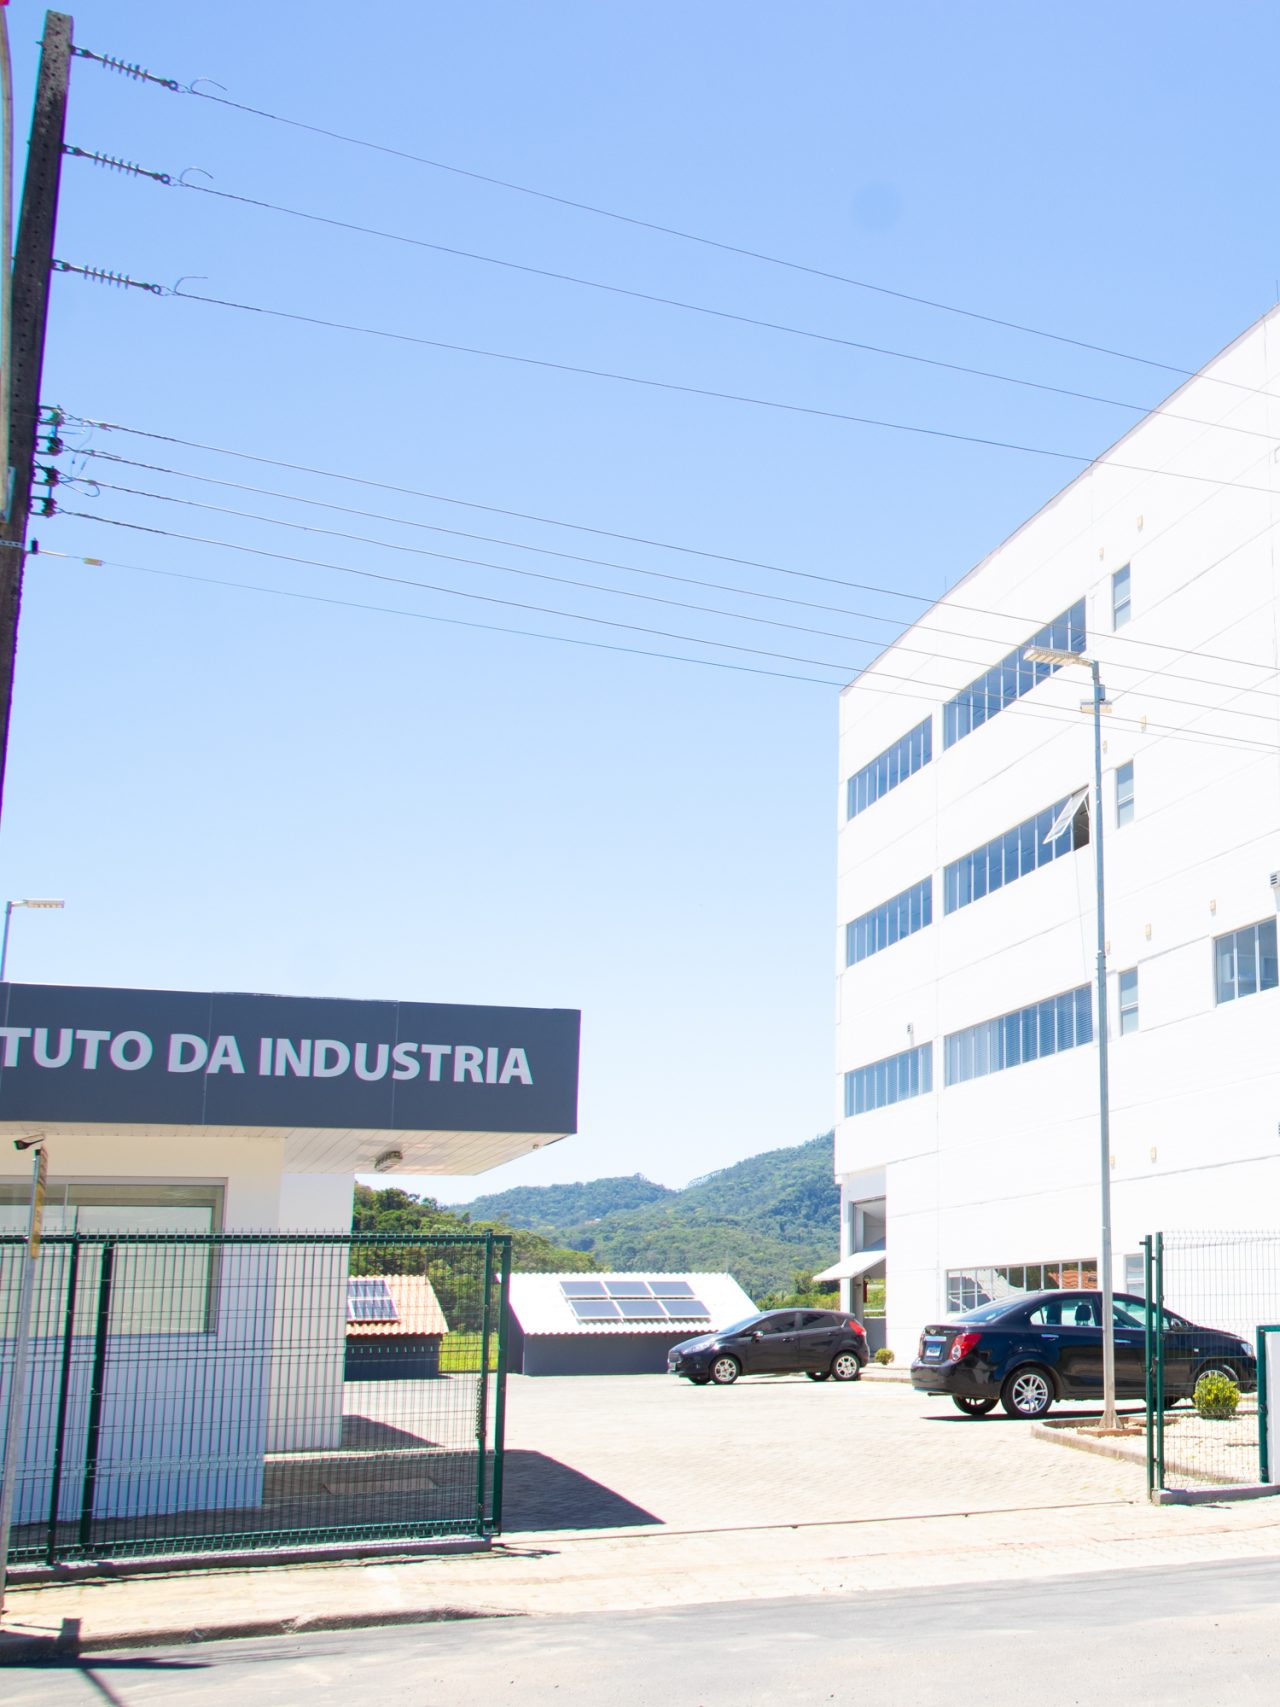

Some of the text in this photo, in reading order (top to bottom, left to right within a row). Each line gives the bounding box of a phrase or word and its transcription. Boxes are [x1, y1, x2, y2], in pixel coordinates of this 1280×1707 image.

[0, 1026, 534, 1085] TUTO DA INDUSTRIA
